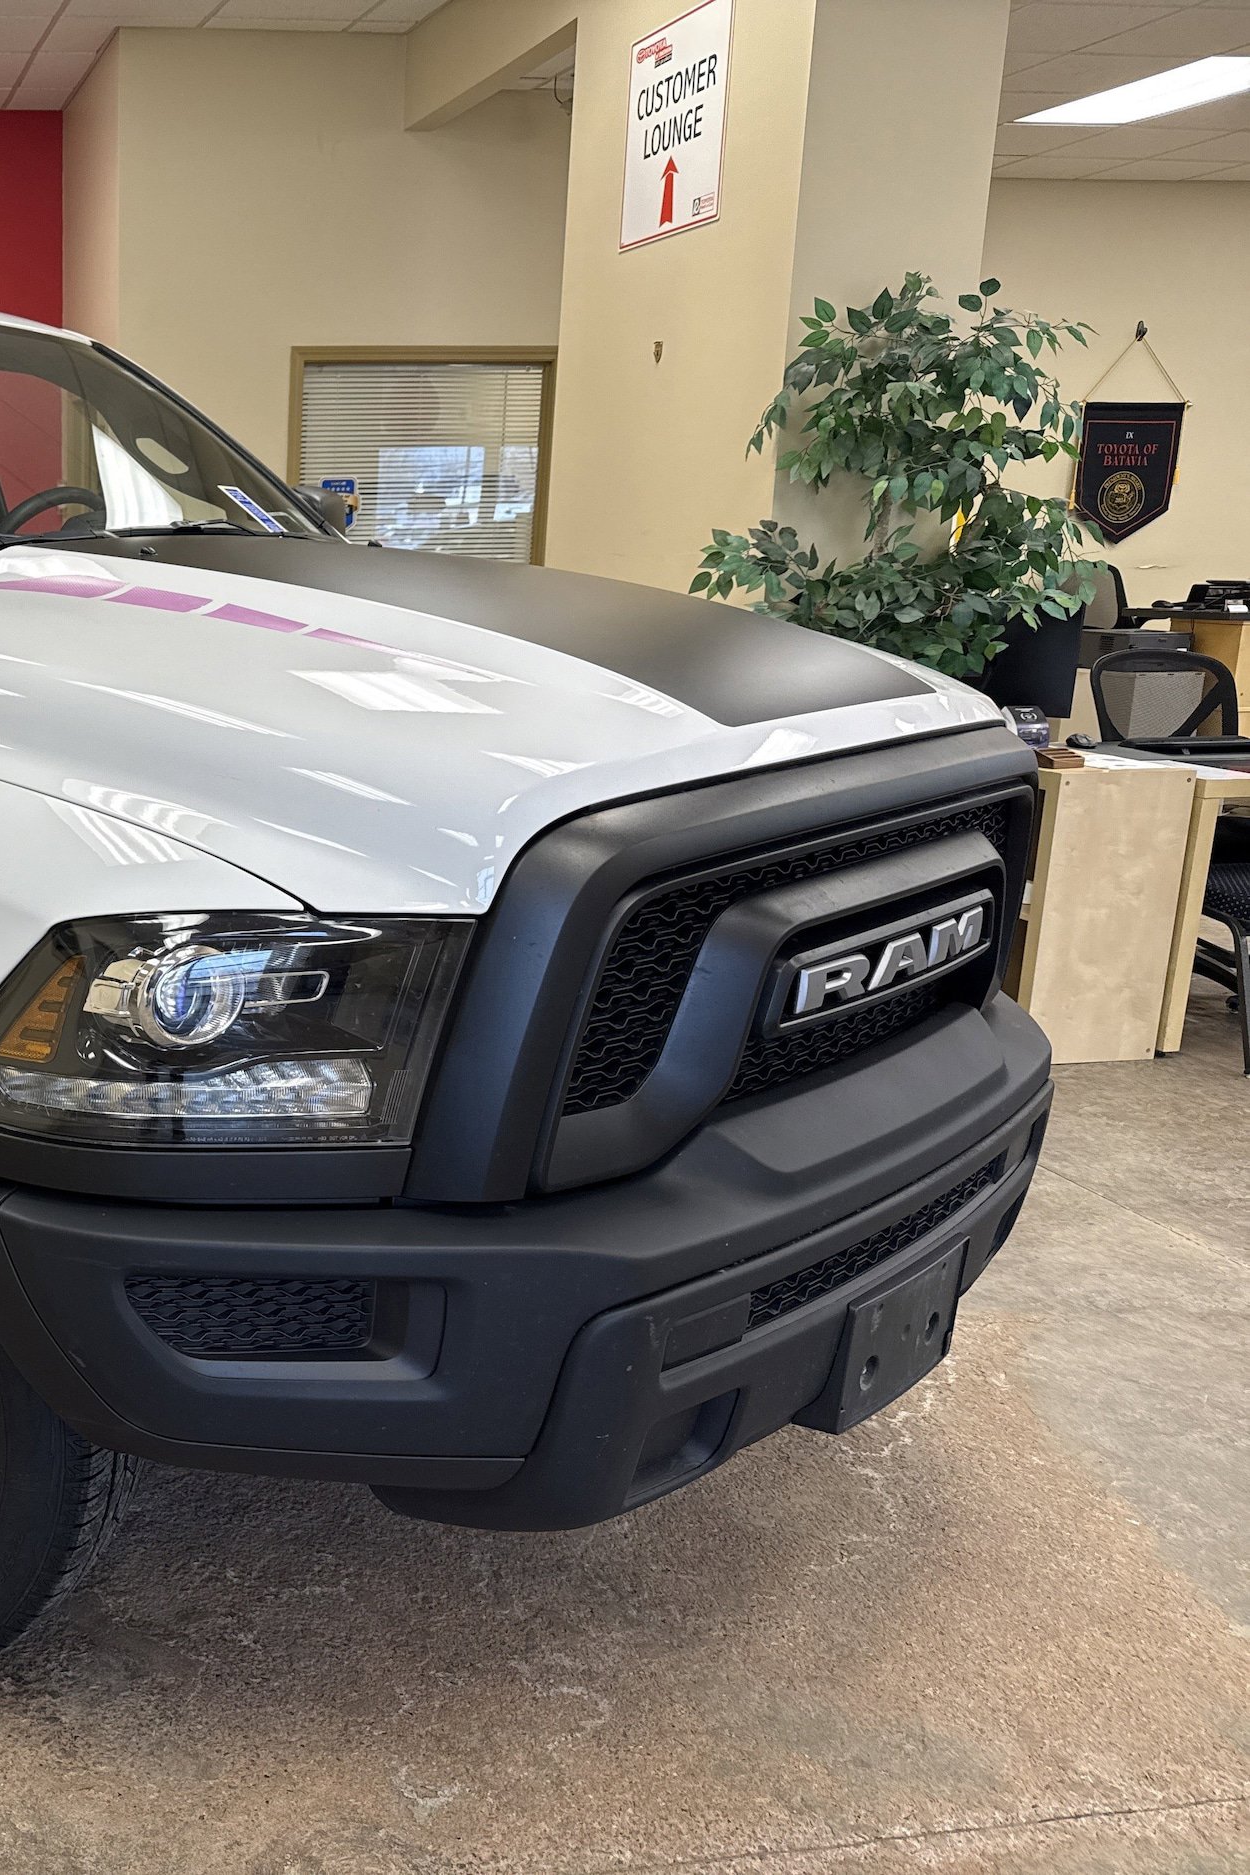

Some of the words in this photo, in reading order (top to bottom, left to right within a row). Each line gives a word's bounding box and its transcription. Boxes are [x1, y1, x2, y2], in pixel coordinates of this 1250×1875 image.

[637, 53, 717, 121] CUSTOMER
[643, 103, 704, 160] LOUNGE
[1097, 443, 1139, 455] TOYOTA
[1143, 443, 1159, 455] OF
[1103, 455, 1148, 466] BATAVIA
[795, 905, 984, 1015] RAM
